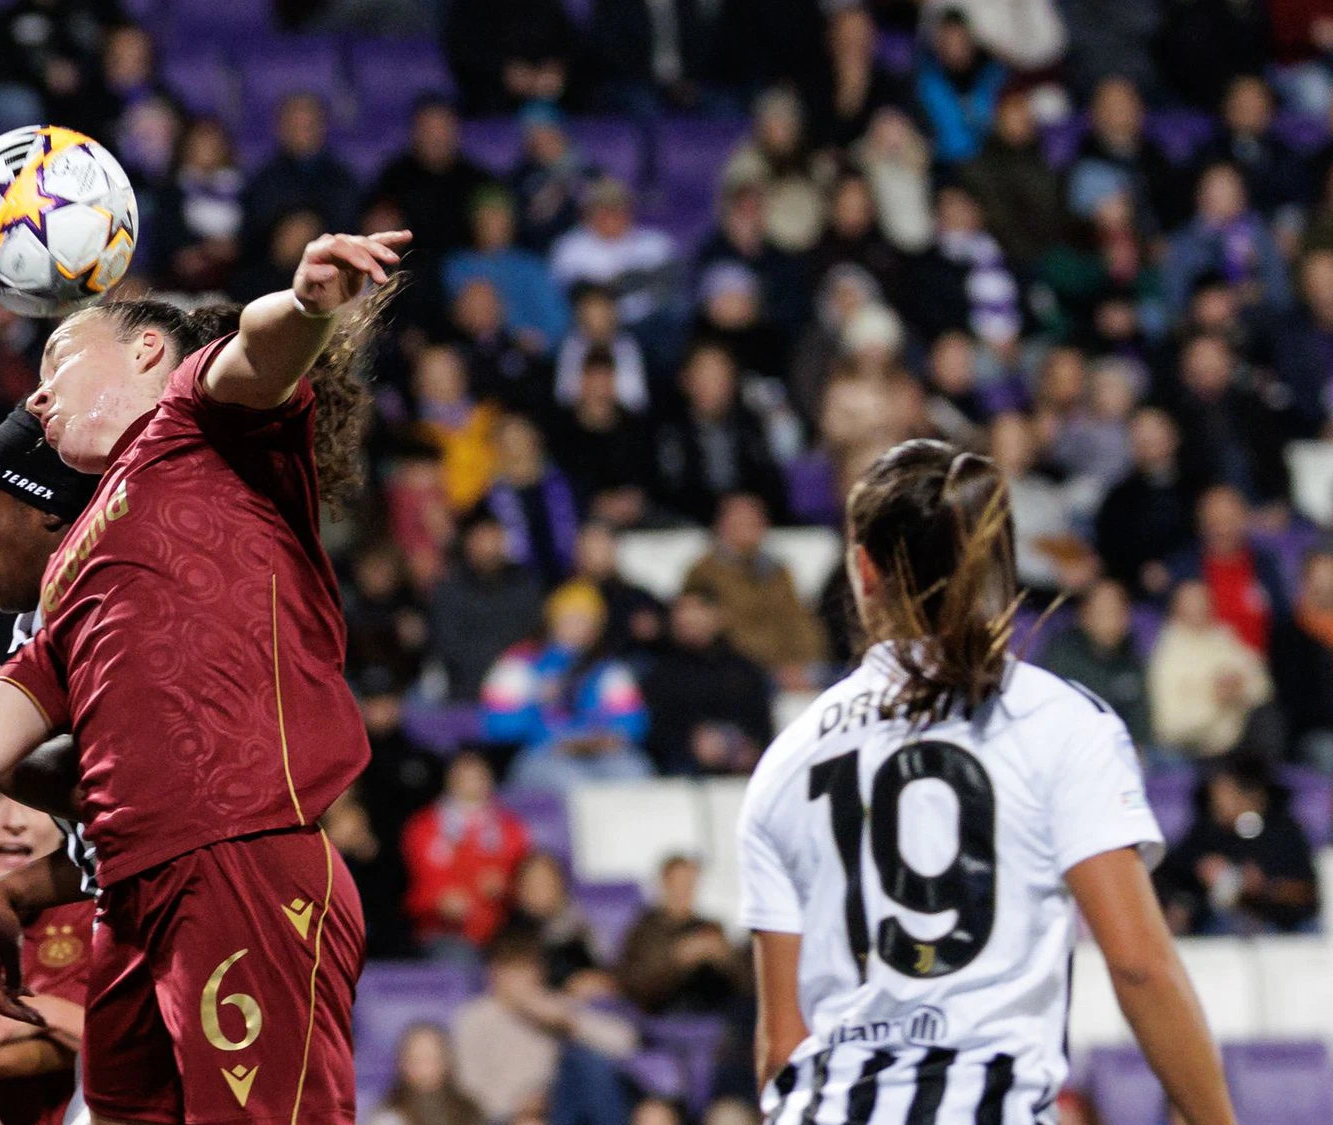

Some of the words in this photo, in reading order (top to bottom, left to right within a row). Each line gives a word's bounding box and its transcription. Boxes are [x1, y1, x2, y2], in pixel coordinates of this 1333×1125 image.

[1, 469, 55, 500] TERREX
[808, 740, 995, 988] 19
[199, 948, 263, 1051] 6
